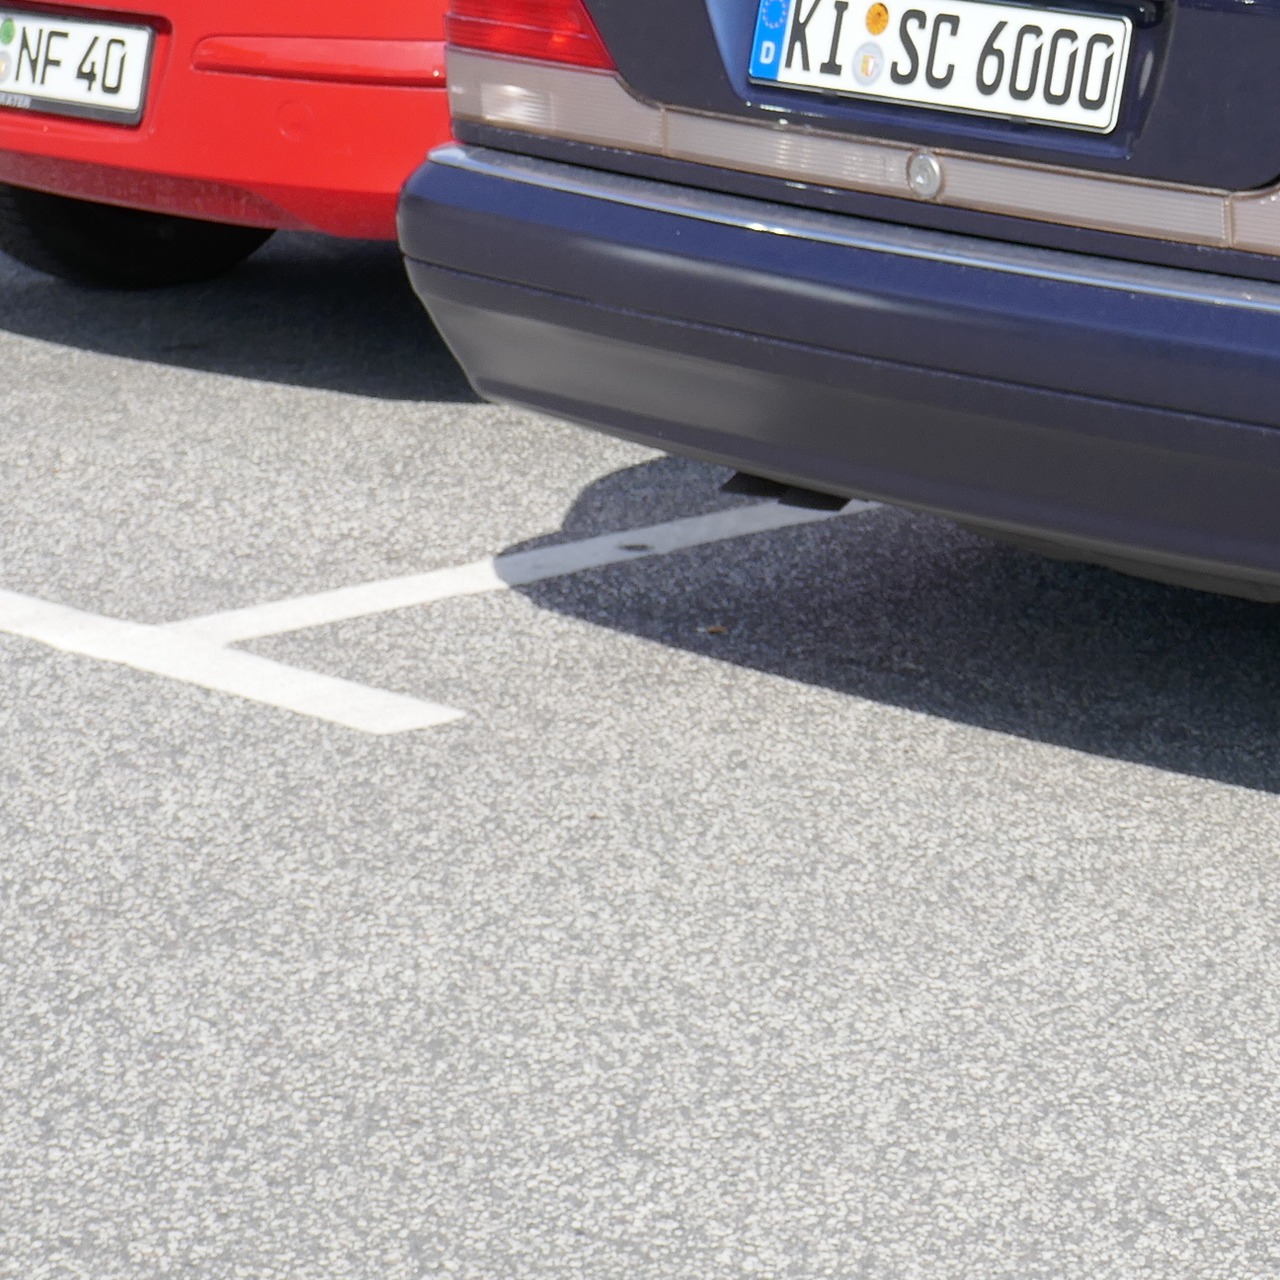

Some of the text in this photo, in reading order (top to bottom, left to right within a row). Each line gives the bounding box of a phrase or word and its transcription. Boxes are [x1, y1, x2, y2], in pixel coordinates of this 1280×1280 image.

[15, 26, 127, 95] NF 40
[759, 41, 775, 65] D
[890, 9, 960, 90] SC
[975, 20, 1115, 111] 6000
